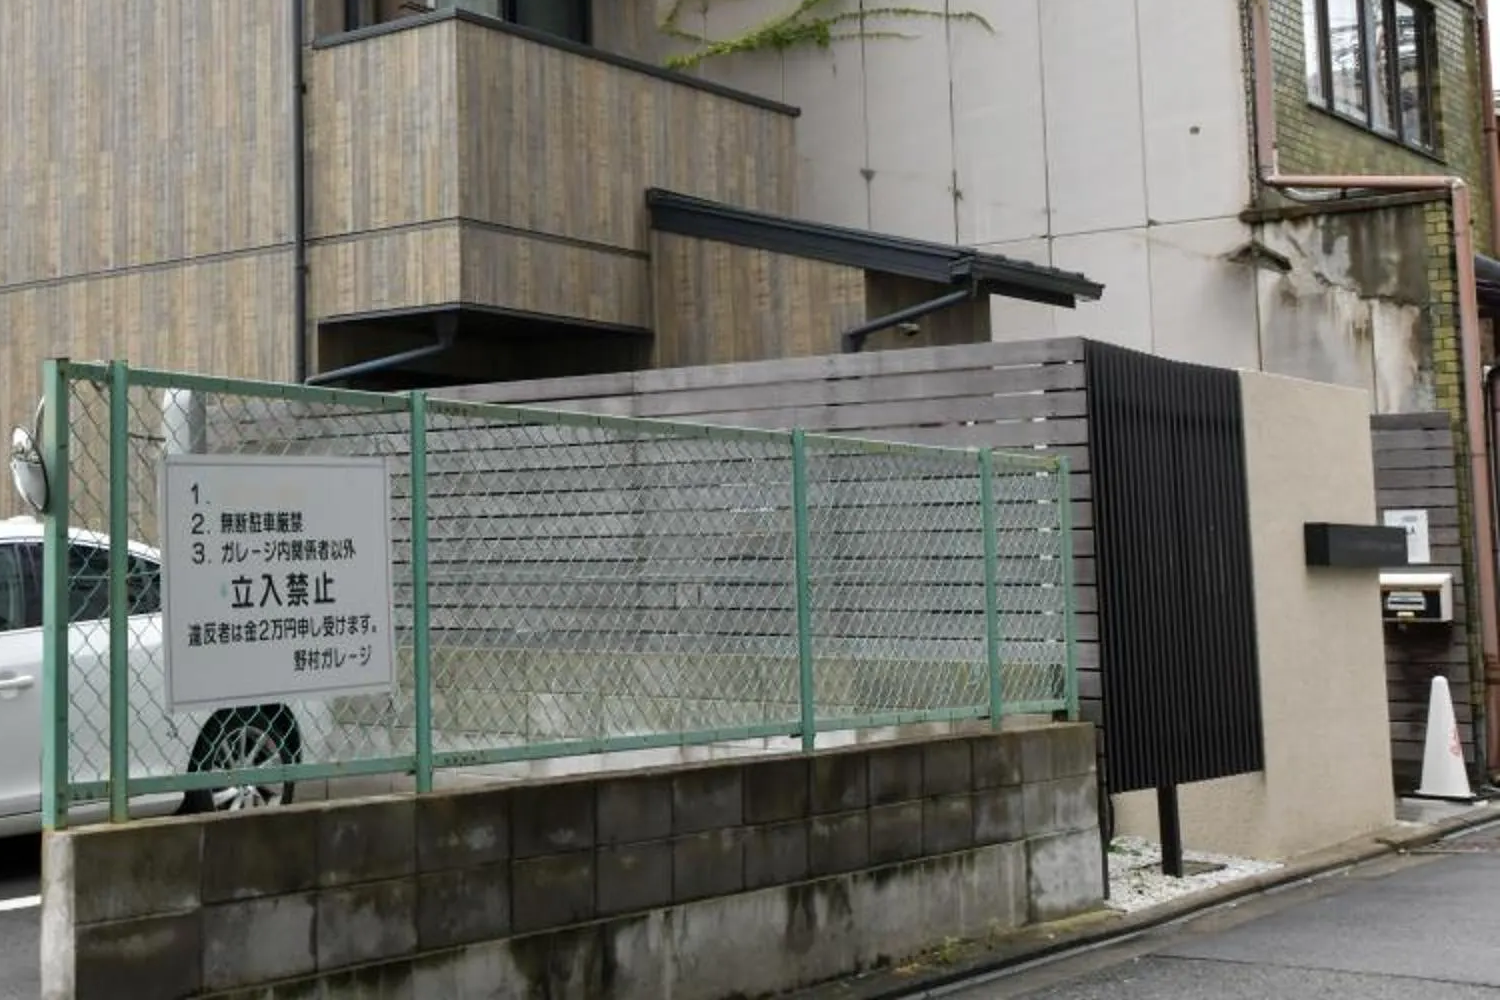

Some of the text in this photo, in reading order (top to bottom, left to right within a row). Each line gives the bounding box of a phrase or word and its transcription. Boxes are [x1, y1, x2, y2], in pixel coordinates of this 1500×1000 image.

[231, 571, 336, 609] 立入禁止
[293, 645, 372, 672] 野村ガレージ
